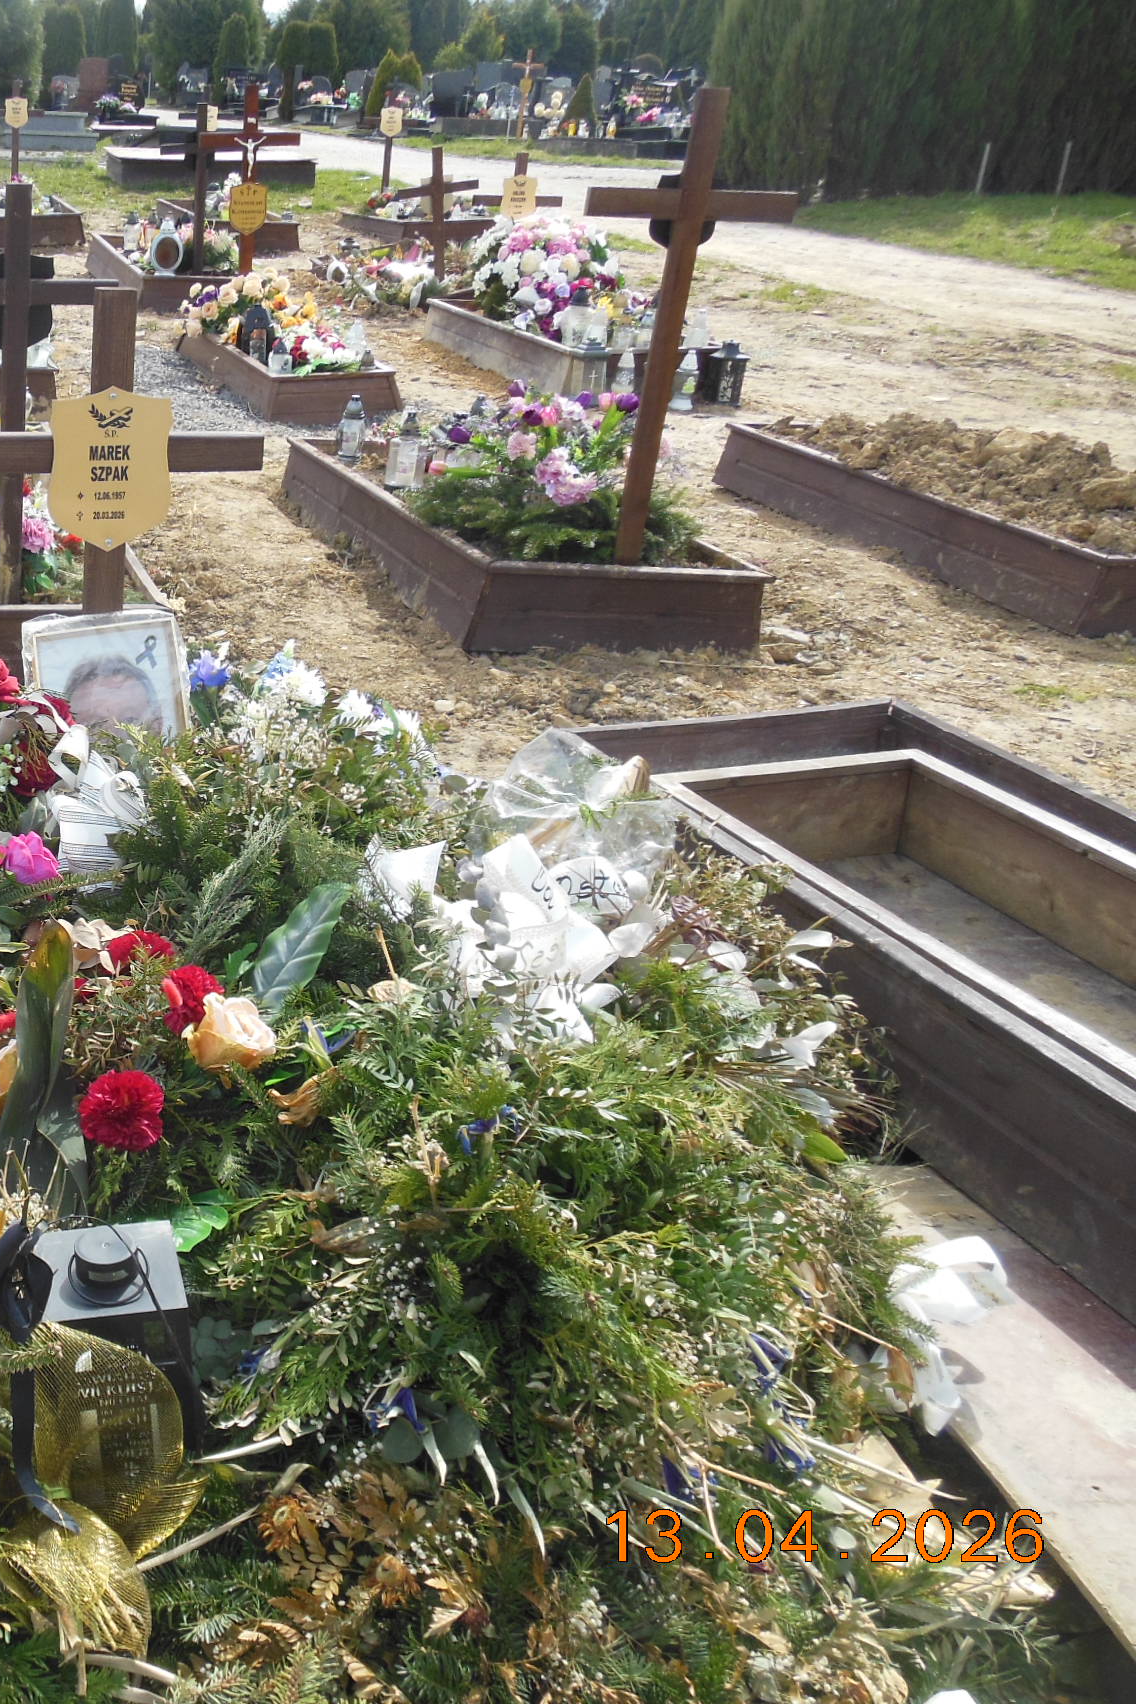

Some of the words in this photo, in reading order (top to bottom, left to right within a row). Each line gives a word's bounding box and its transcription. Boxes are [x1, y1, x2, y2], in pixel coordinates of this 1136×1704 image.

[89, 445, 131, 461] MAREK
[90, 466, 129, 481] SZPAK
[93, 511, 125, 520] 20.03.2026
